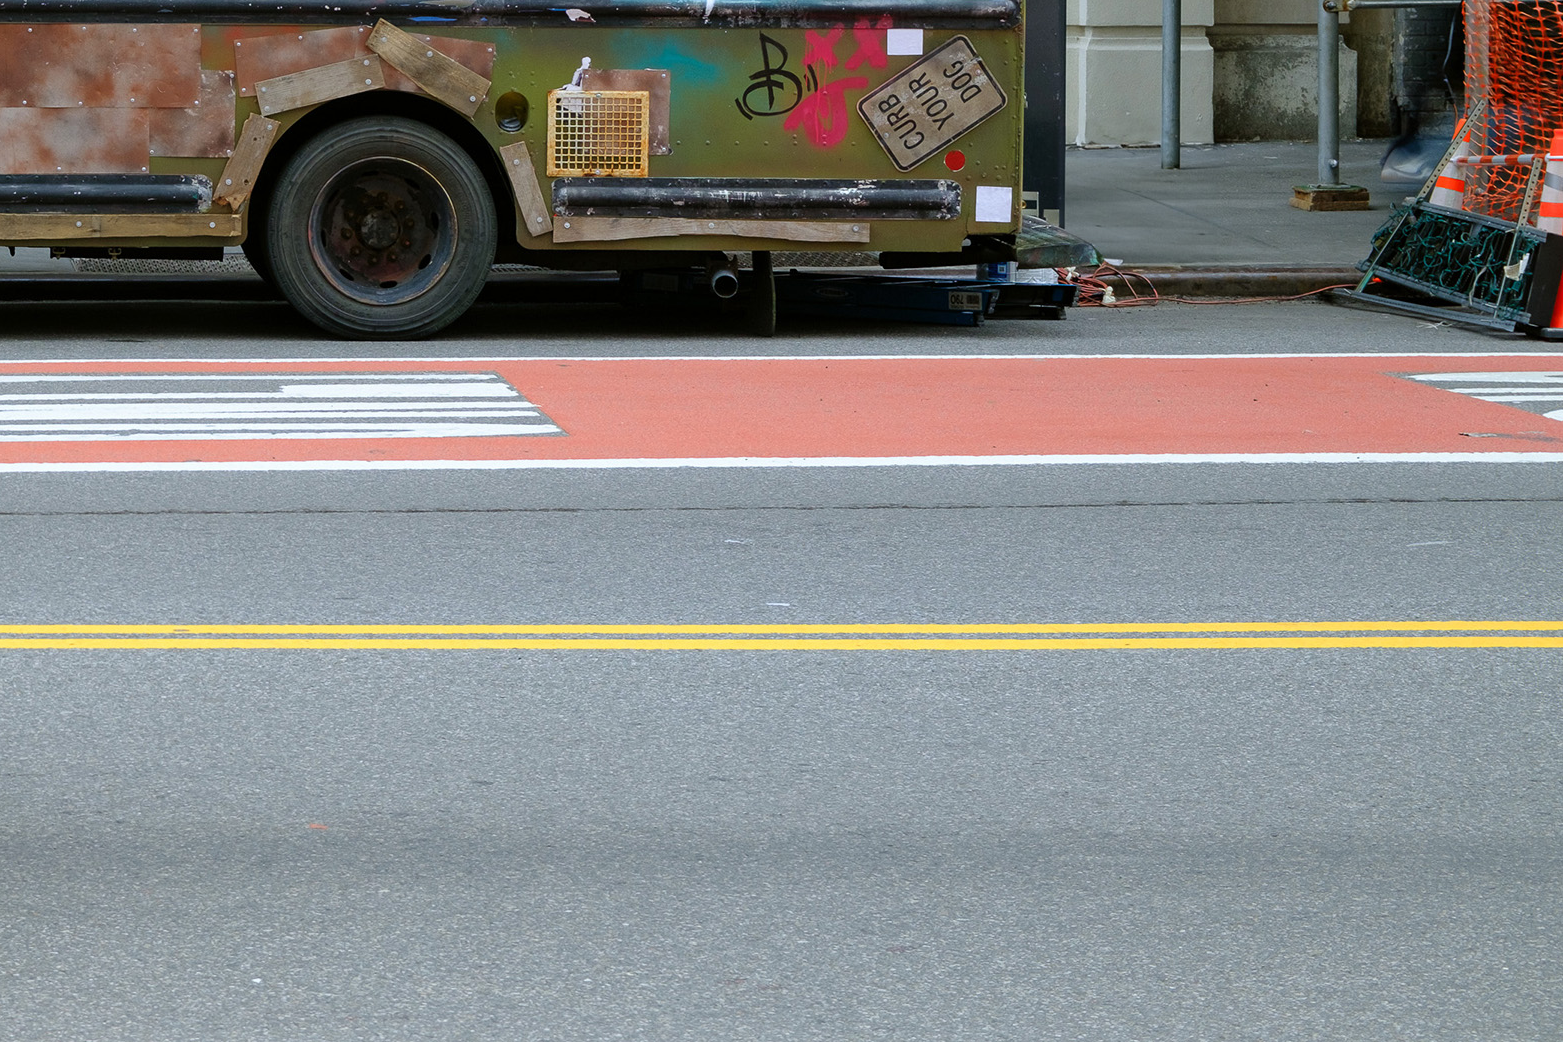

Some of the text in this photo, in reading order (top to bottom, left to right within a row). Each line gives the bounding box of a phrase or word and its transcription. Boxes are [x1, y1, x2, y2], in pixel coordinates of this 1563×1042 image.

[907, 71, 955, 132] YOUR
[942, 59, 983, 105] DOG
[877, 92, 926, 151] CURB
